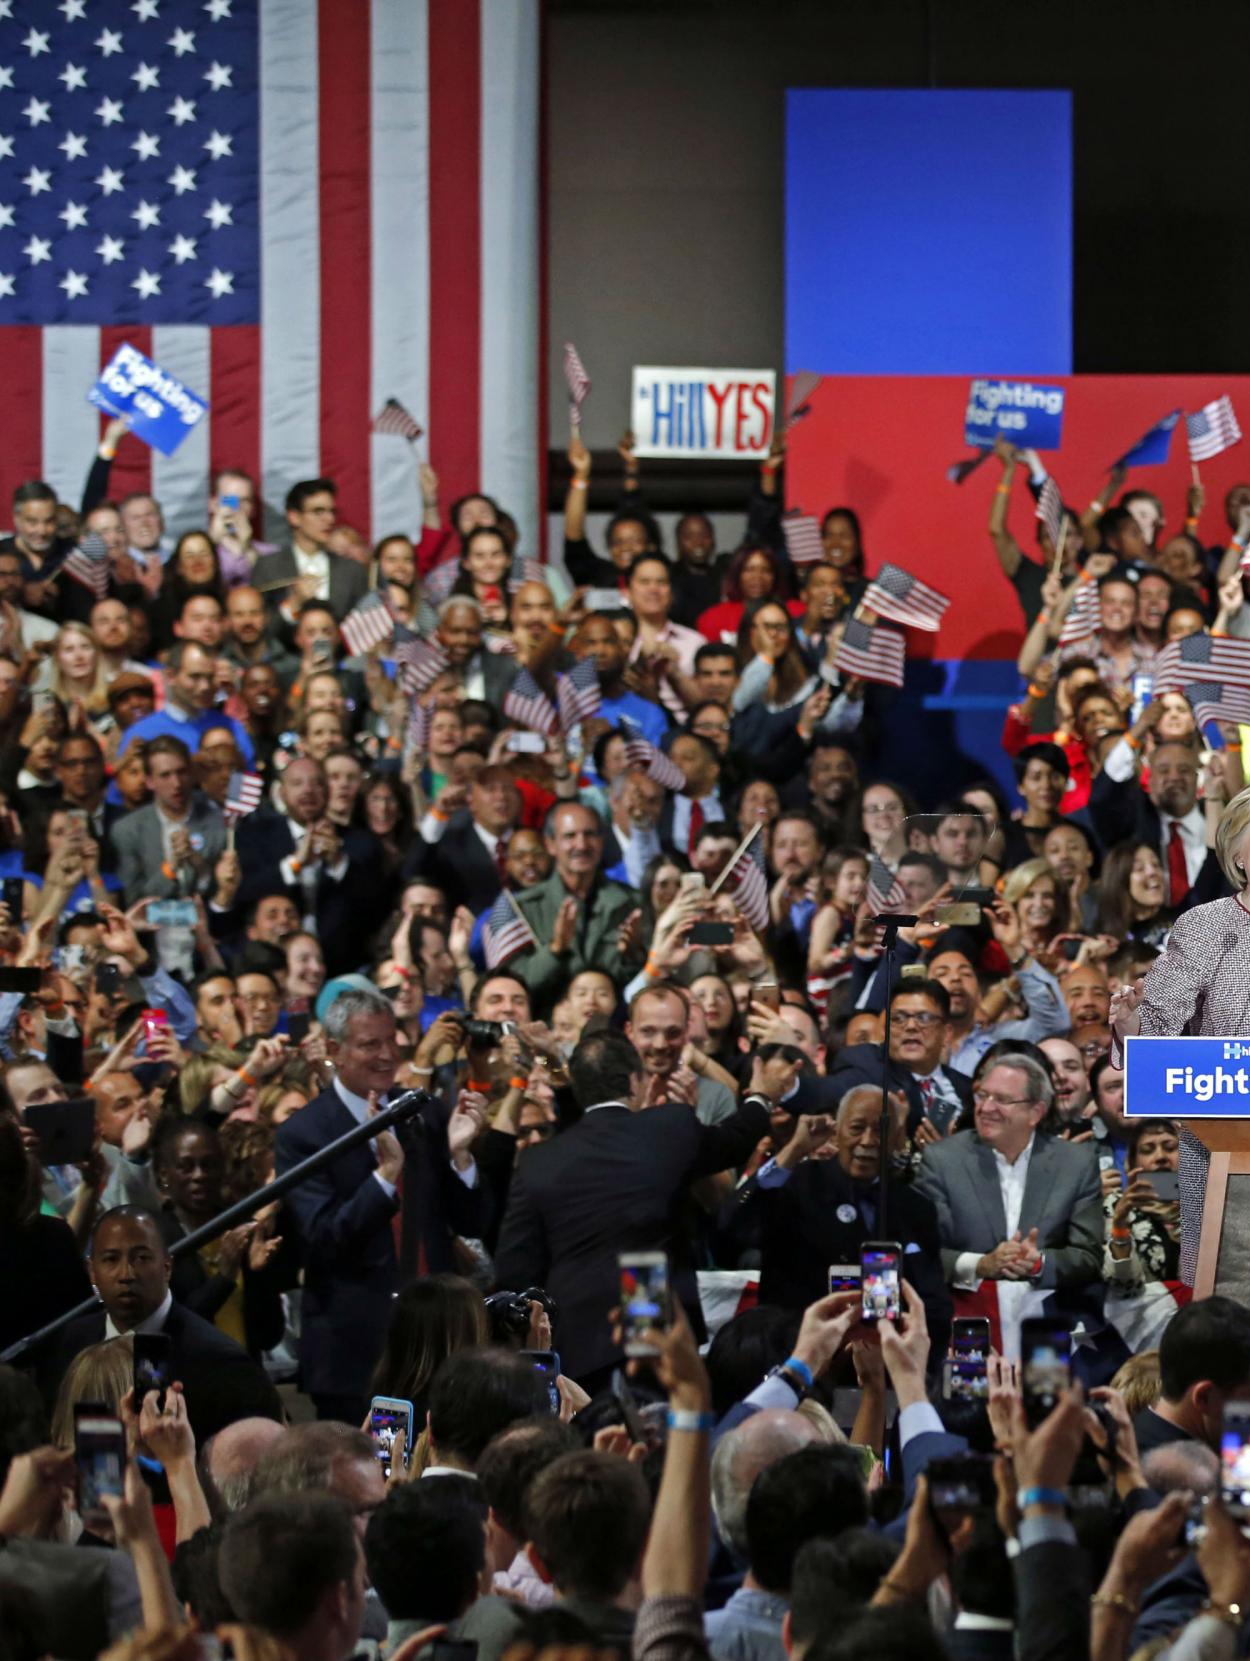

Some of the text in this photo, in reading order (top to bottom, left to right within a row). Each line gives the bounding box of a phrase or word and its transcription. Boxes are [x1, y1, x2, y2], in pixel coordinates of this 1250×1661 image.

[116, 346, 204, 425] Fighting
[970, 381, 1064, 415] Fighting
[133, 390, 164, 419] us
[997, 411, 1027, 430] us
